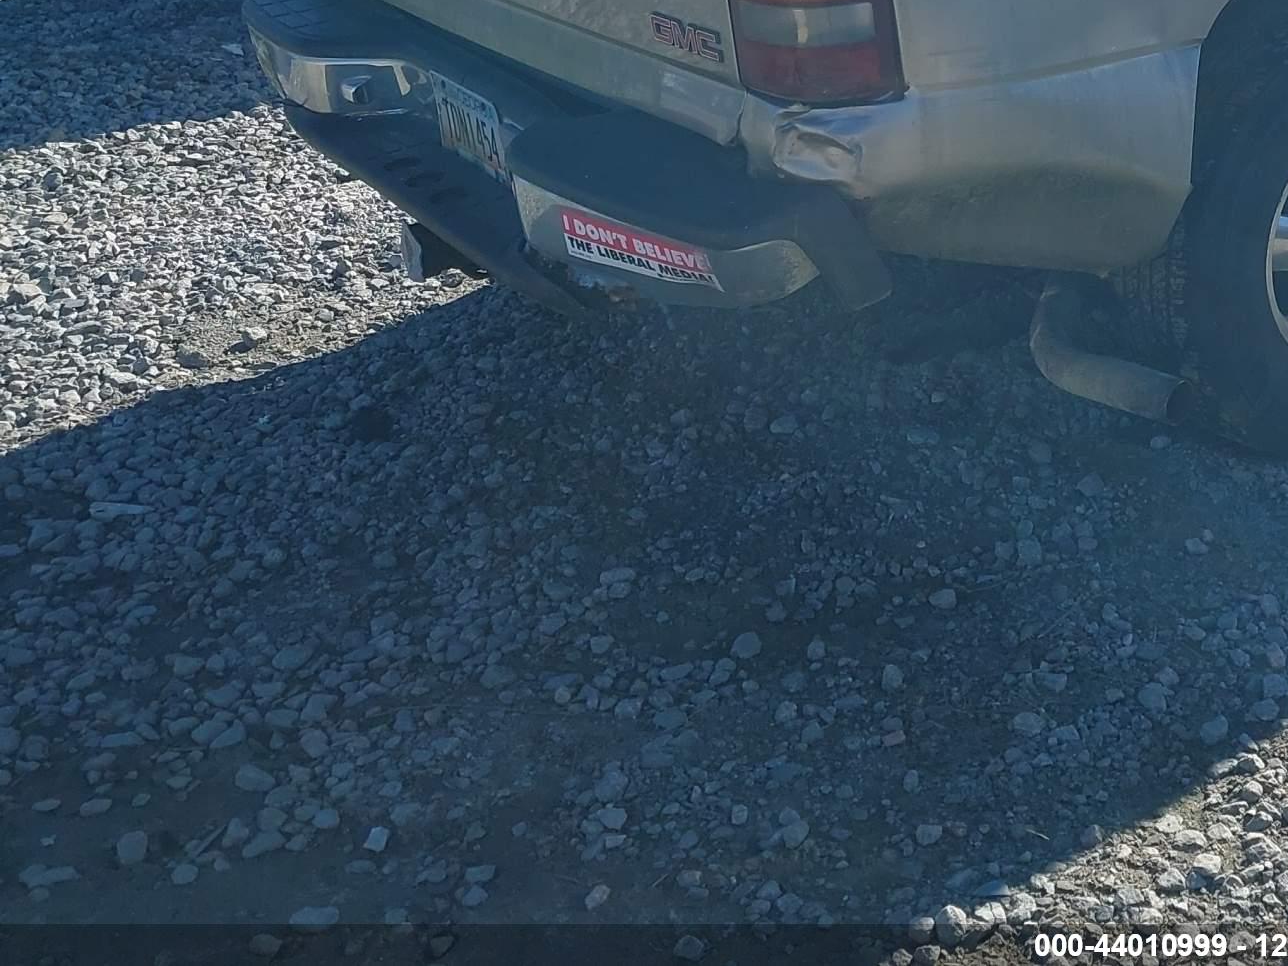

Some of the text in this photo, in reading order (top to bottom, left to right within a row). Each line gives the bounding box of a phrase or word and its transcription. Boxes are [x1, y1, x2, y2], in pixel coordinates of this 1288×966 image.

[649, 14, 719, 62] GMC
[562, 214, 570, 231] I
[573, 218, 628, 249] DON'T
[568, 237, 594, 255] THE
[596, 245, 657, 272] LIBERAL
